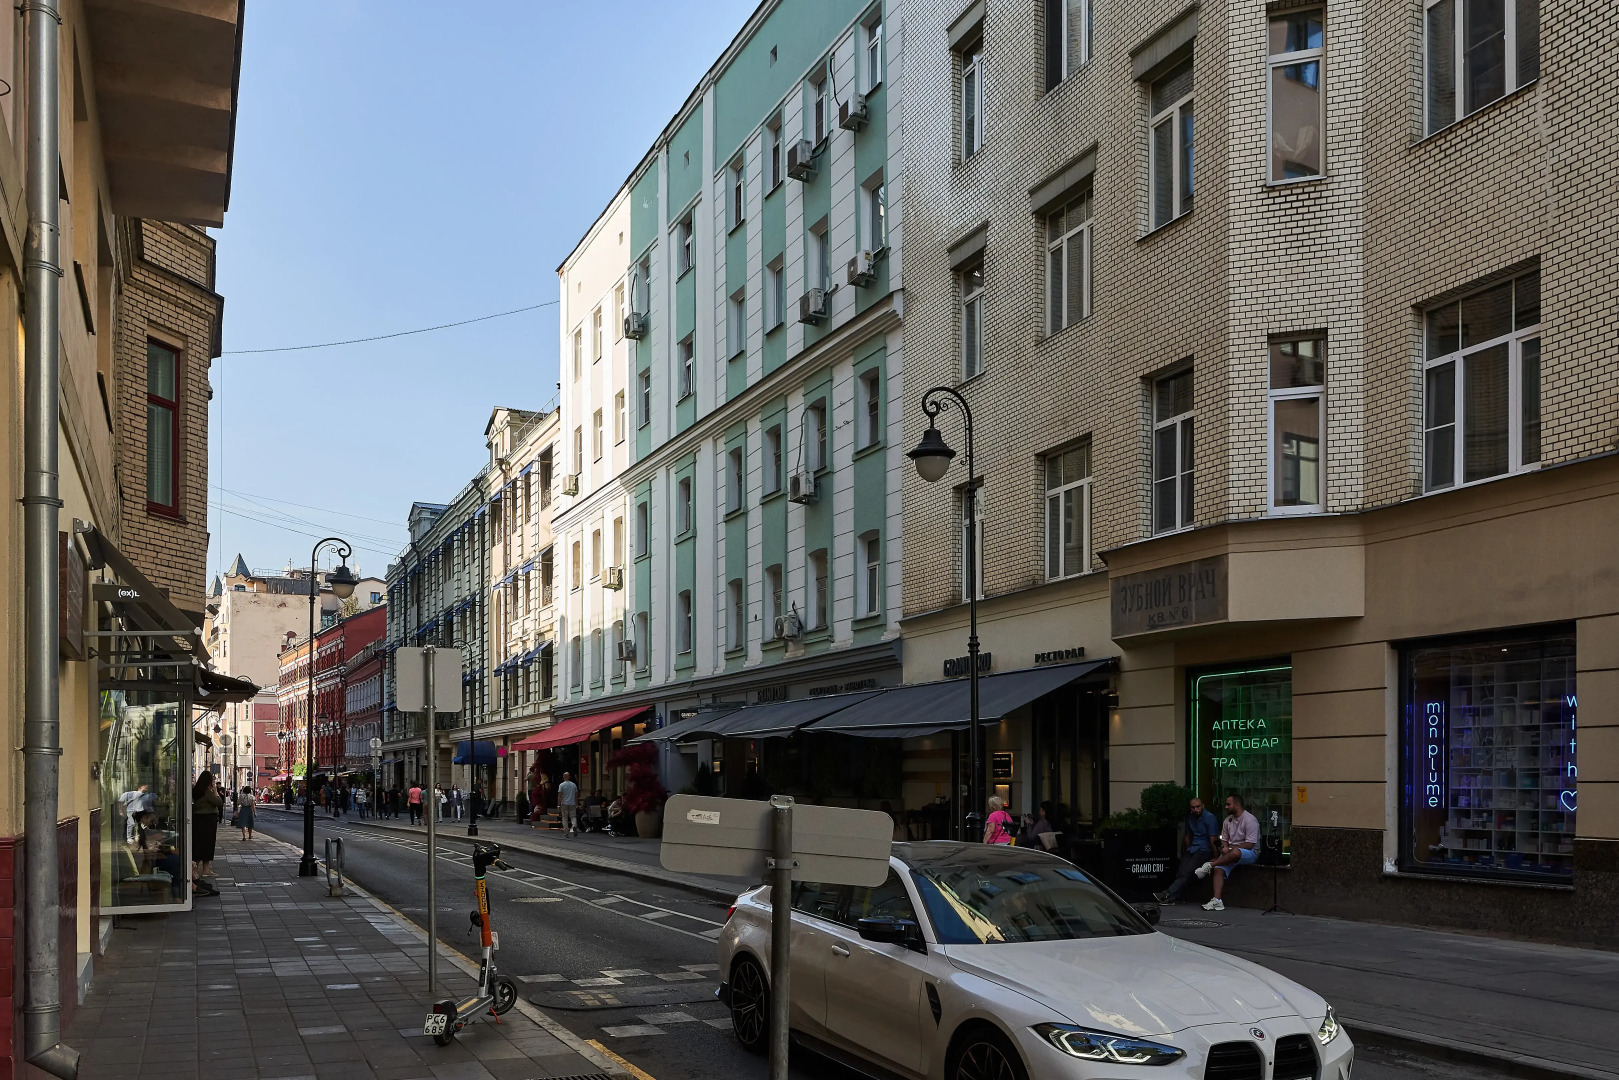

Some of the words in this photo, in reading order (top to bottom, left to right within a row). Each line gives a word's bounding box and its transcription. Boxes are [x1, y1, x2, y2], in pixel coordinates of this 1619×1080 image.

[1120, 574, 1172, 613] ЗУБНОЙ
[1178, 568, 1216, 603] ВРАЧ
[1034, 646, 1085, 663] РЕСТОРАН
[1212, 718, 1267, 731] АПТЕКА
[1426, 702, 1440, 738] mon
[1211, 737, 1279, 750] ФИТОБАР
[1426, 744, 1440, 807] plume
[1131, 863, 1152, 874] GRAND
[1152, 863, 1164, 873] CRU
[425, 1025, 444, 1034] 685
